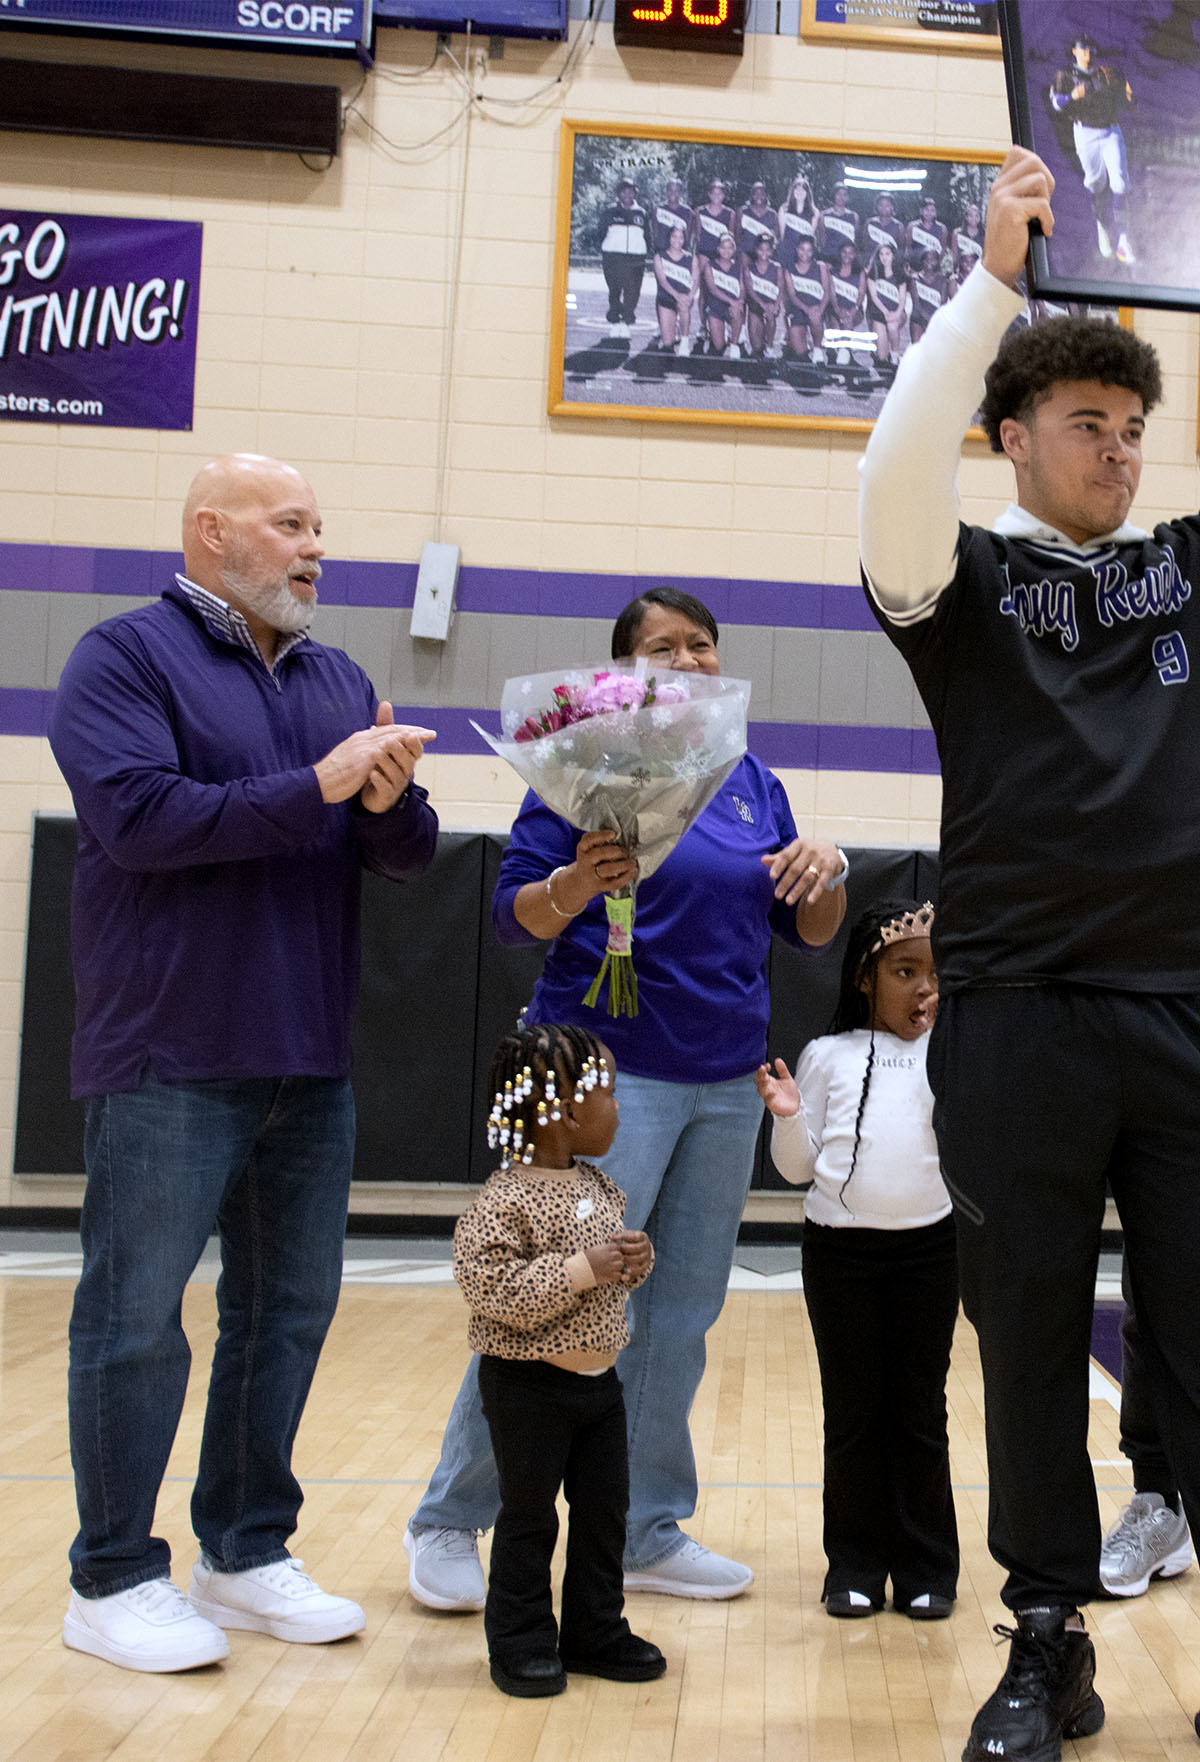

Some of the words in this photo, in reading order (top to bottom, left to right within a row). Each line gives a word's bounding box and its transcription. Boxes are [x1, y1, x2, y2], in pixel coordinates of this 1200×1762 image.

[835, 3, 865, 15] Class
[886, 8, 914, 19] State
[918, 9, 981, 25] Champions
[902, 0, 939, 10] Indoor
[943, 1, 975, 13] Track
[620, 157, 666, 167] TRACK
[0, 277, 185, 357] TNING!
[1091, 543, 1192, 628] Reach
[1152, 630, 1189, 686] 9
